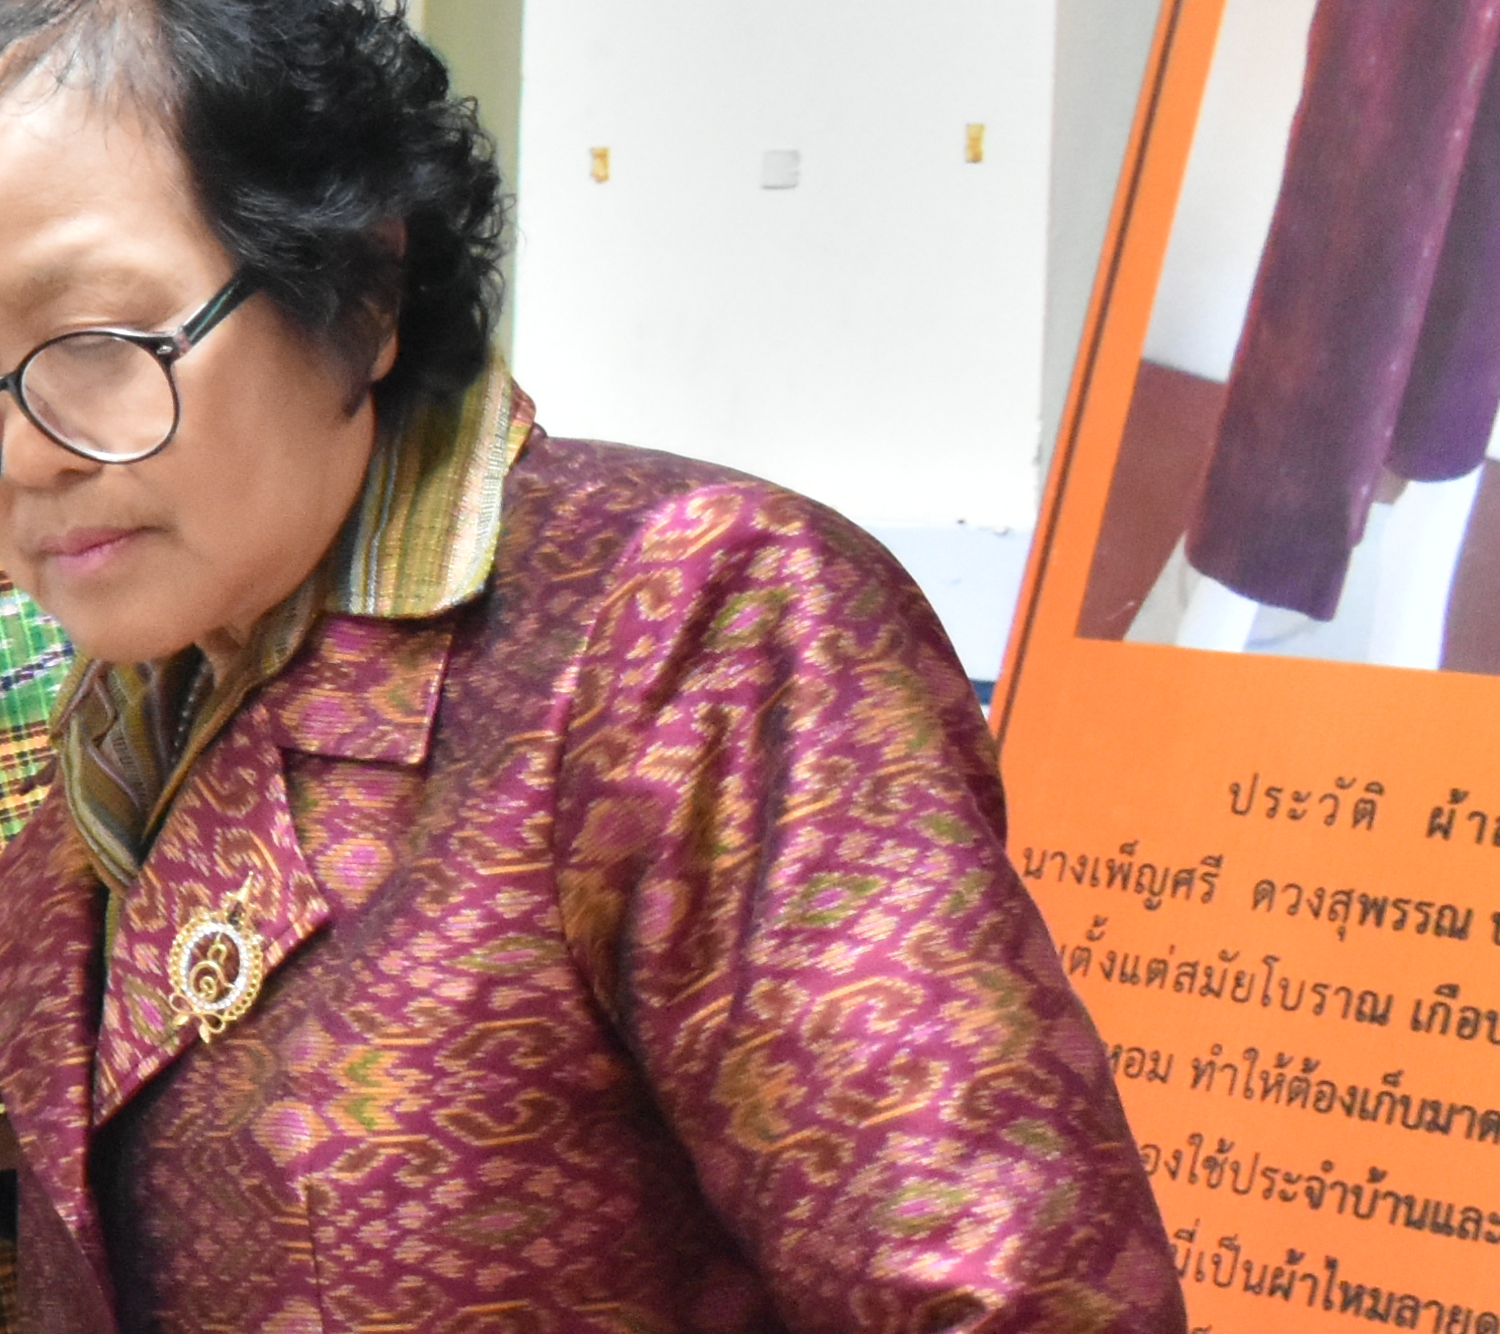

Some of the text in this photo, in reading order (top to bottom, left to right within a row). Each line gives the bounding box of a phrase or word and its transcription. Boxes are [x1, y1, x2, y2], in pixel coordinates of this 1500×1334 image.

[1229, 772, 1386, 833] ประวัติ
[1022, 840, 1224, 911] นางเพ็ญศรี
[1251, 878, 1474, 943] ดวงสุพรรณ
[1060, 915, 1394, 1028] ตั้งแต่สมัยโบราณ
